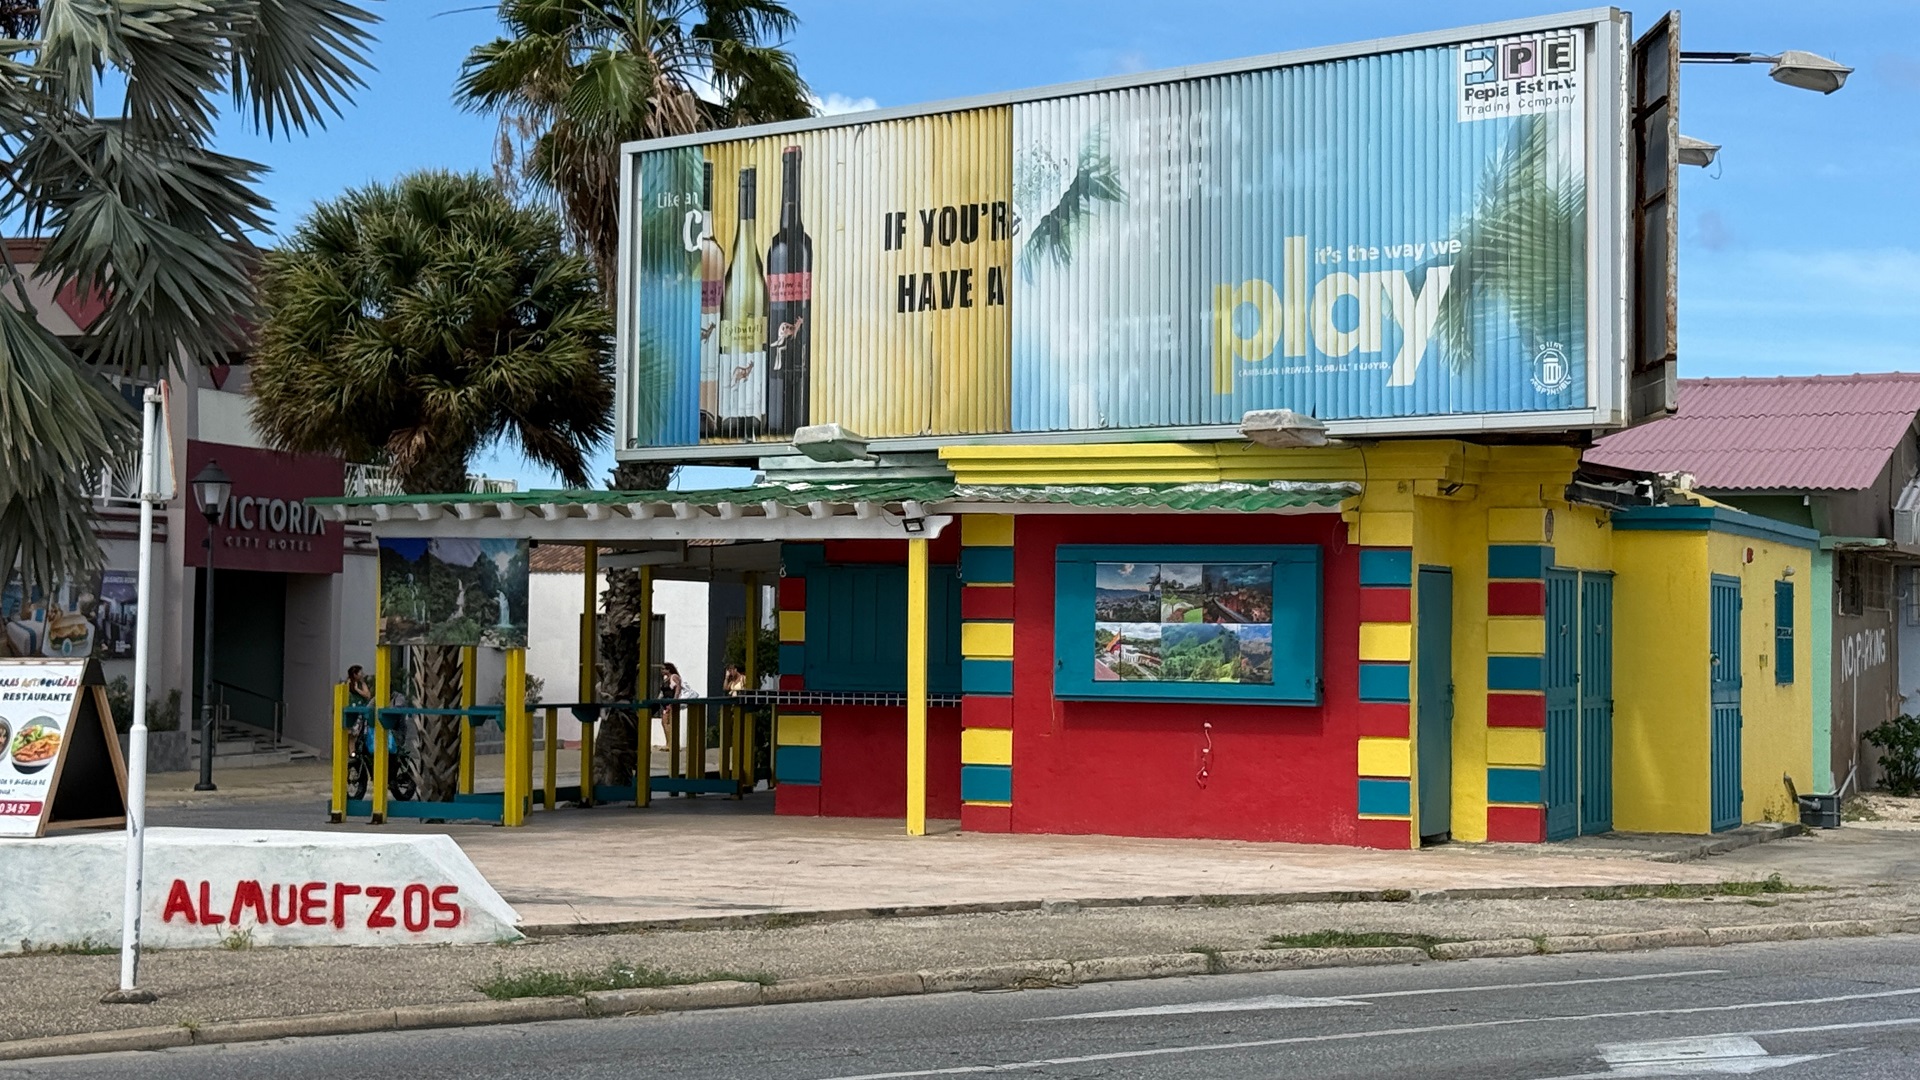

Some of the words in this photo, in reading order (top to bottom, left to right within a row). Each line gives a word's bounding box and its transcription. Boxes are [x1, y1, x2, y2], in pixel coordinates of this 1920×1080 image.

[1464, 84, 1509, 101] Pepia
[1516, 79, 1543, 95] Est
[1465, 103, 1510, 116] Trading
[1518, 94, 1576, 109] Company
[885, 211, 906, 251] IF
[919, 201, 1010, 248] YOU'R
[1315, 245, 1341, 265] it's
[1348, 244, 1379, 262] the
[1384, 242, 1425, 262] way
[1430, 238, 1462, 255] we
[898, 267, 973, 313] HAVE
[985, 265, 1004, 306] A
[1214, 235, 1455, 395] play
[226, 535, 260, 549] CITY
[268, 538, 312, 552] HOTEL
[1841, 634, 1854, 684] NO
[1855, 628, 1886, 678] PARKING
[3, 692, 72, 702] RESTAURANTE
[5, 803, 17, 814] 34
[17, 803, 31, 814] 57
